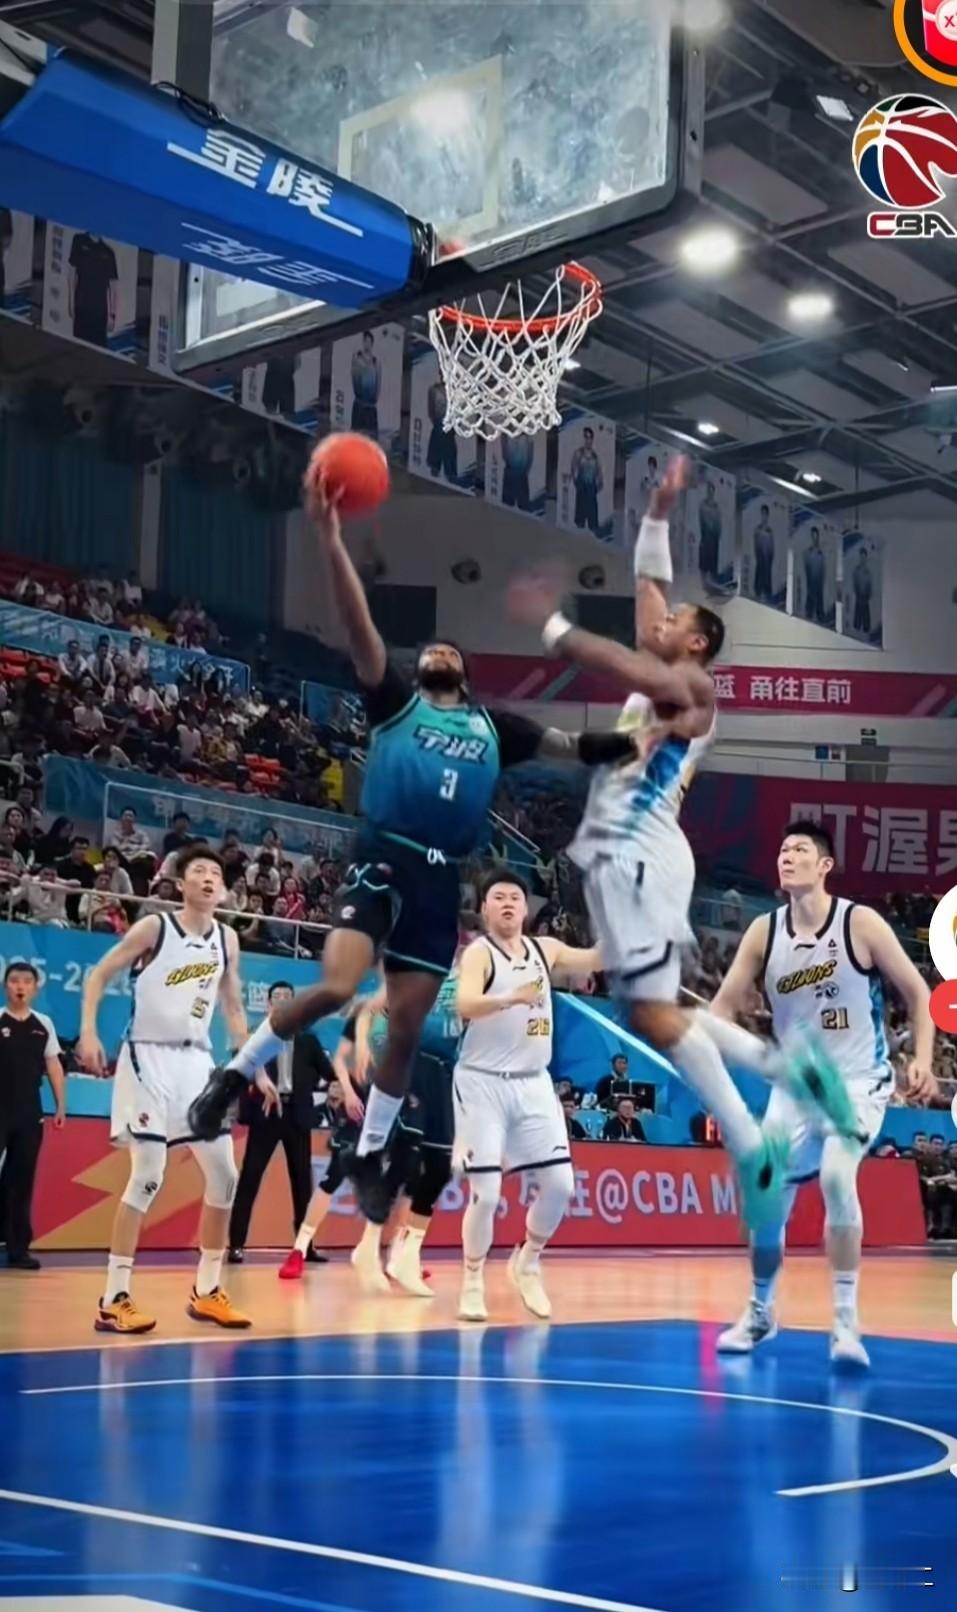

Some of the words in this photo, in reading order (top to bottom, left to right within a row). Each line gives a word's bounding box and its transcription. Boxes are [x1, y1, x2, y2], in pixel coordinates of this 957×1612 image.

[167, 128, 364, 238] 金陵
[750, 675, 852, 704] 甬往直前
[439, 767, 459, 801] 3
[821, 1007, 849, 1030] 21
